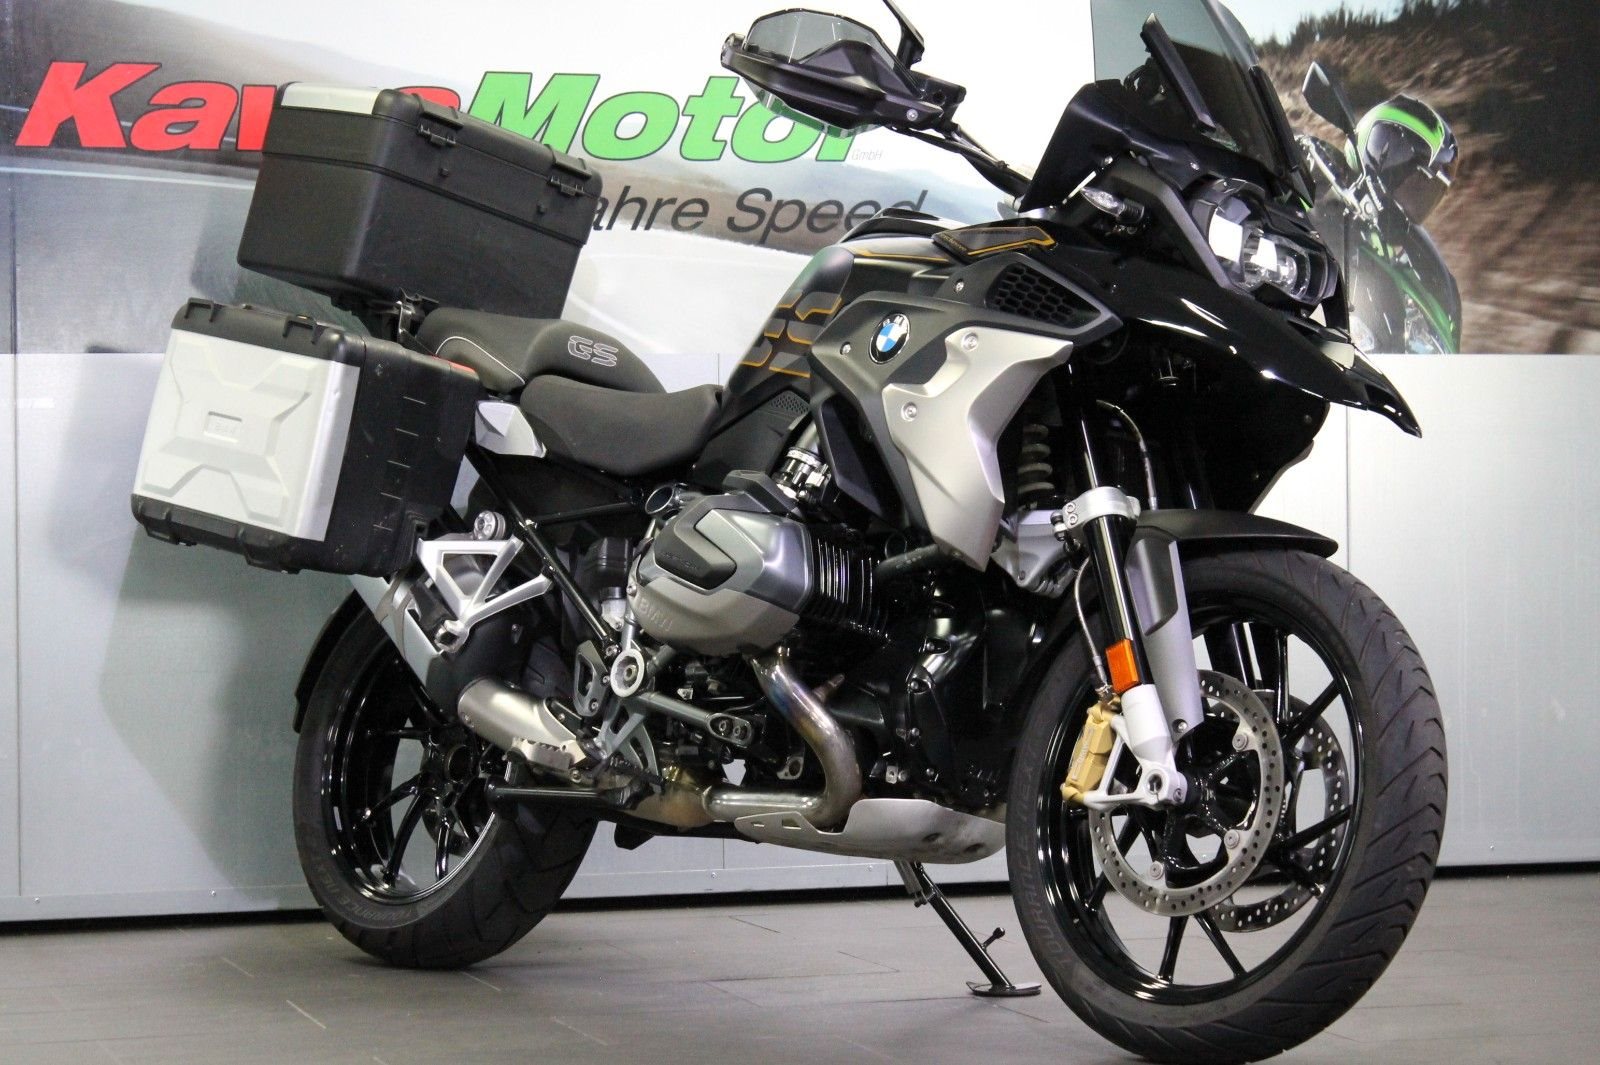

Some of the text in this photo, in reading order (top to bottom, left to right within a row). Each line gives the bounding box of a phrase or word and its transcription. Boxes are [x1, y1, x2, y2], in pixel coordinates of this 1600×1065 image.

[851, 149, 884, 161] GmbH
[593, 185, 710, 232] ahre
[567, 335, 619, 367] GS
